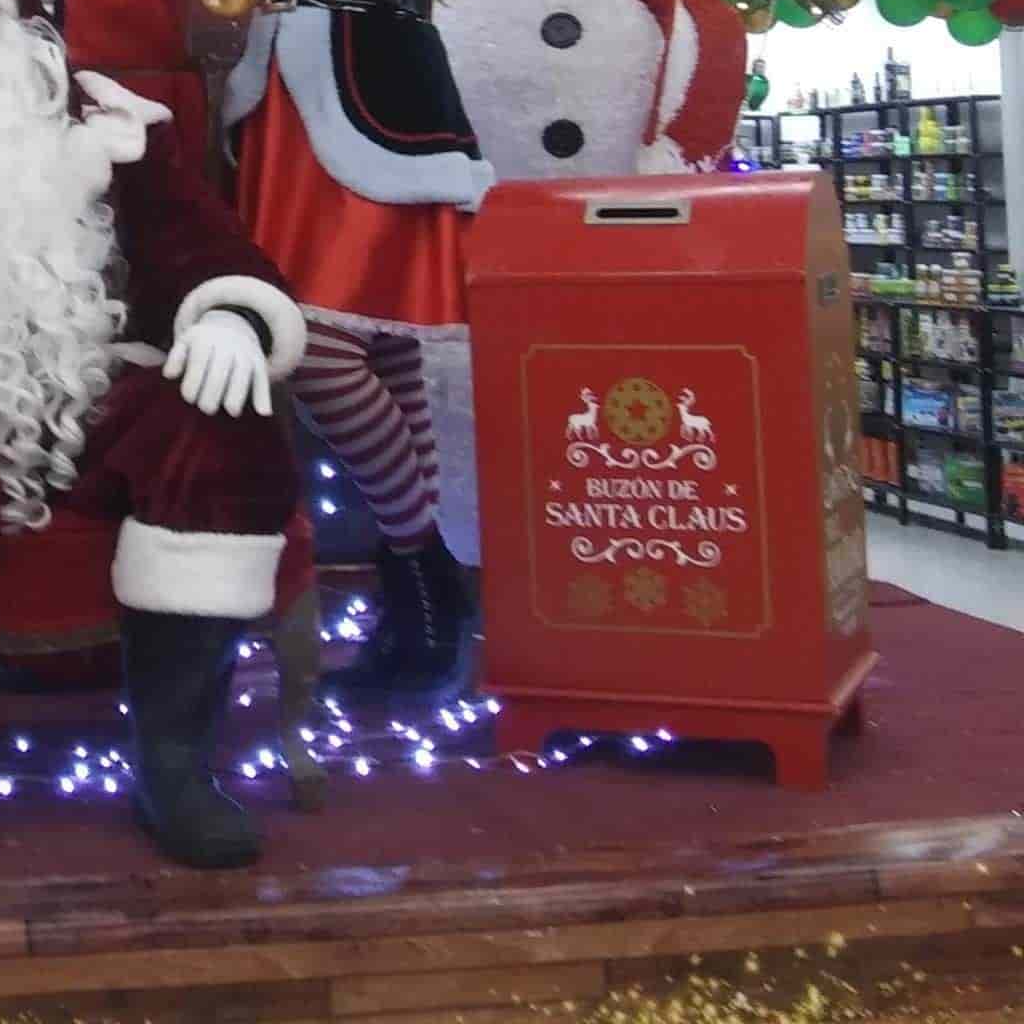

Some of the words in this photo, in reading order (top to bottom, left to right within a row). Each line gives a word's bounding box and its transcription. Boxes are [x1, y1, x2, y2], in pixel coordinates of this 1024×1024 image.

[667, 479, 699, 501] DE
[544, 502, 642, 528] SANTA
[647, 505, 747, 532] CLAUS
